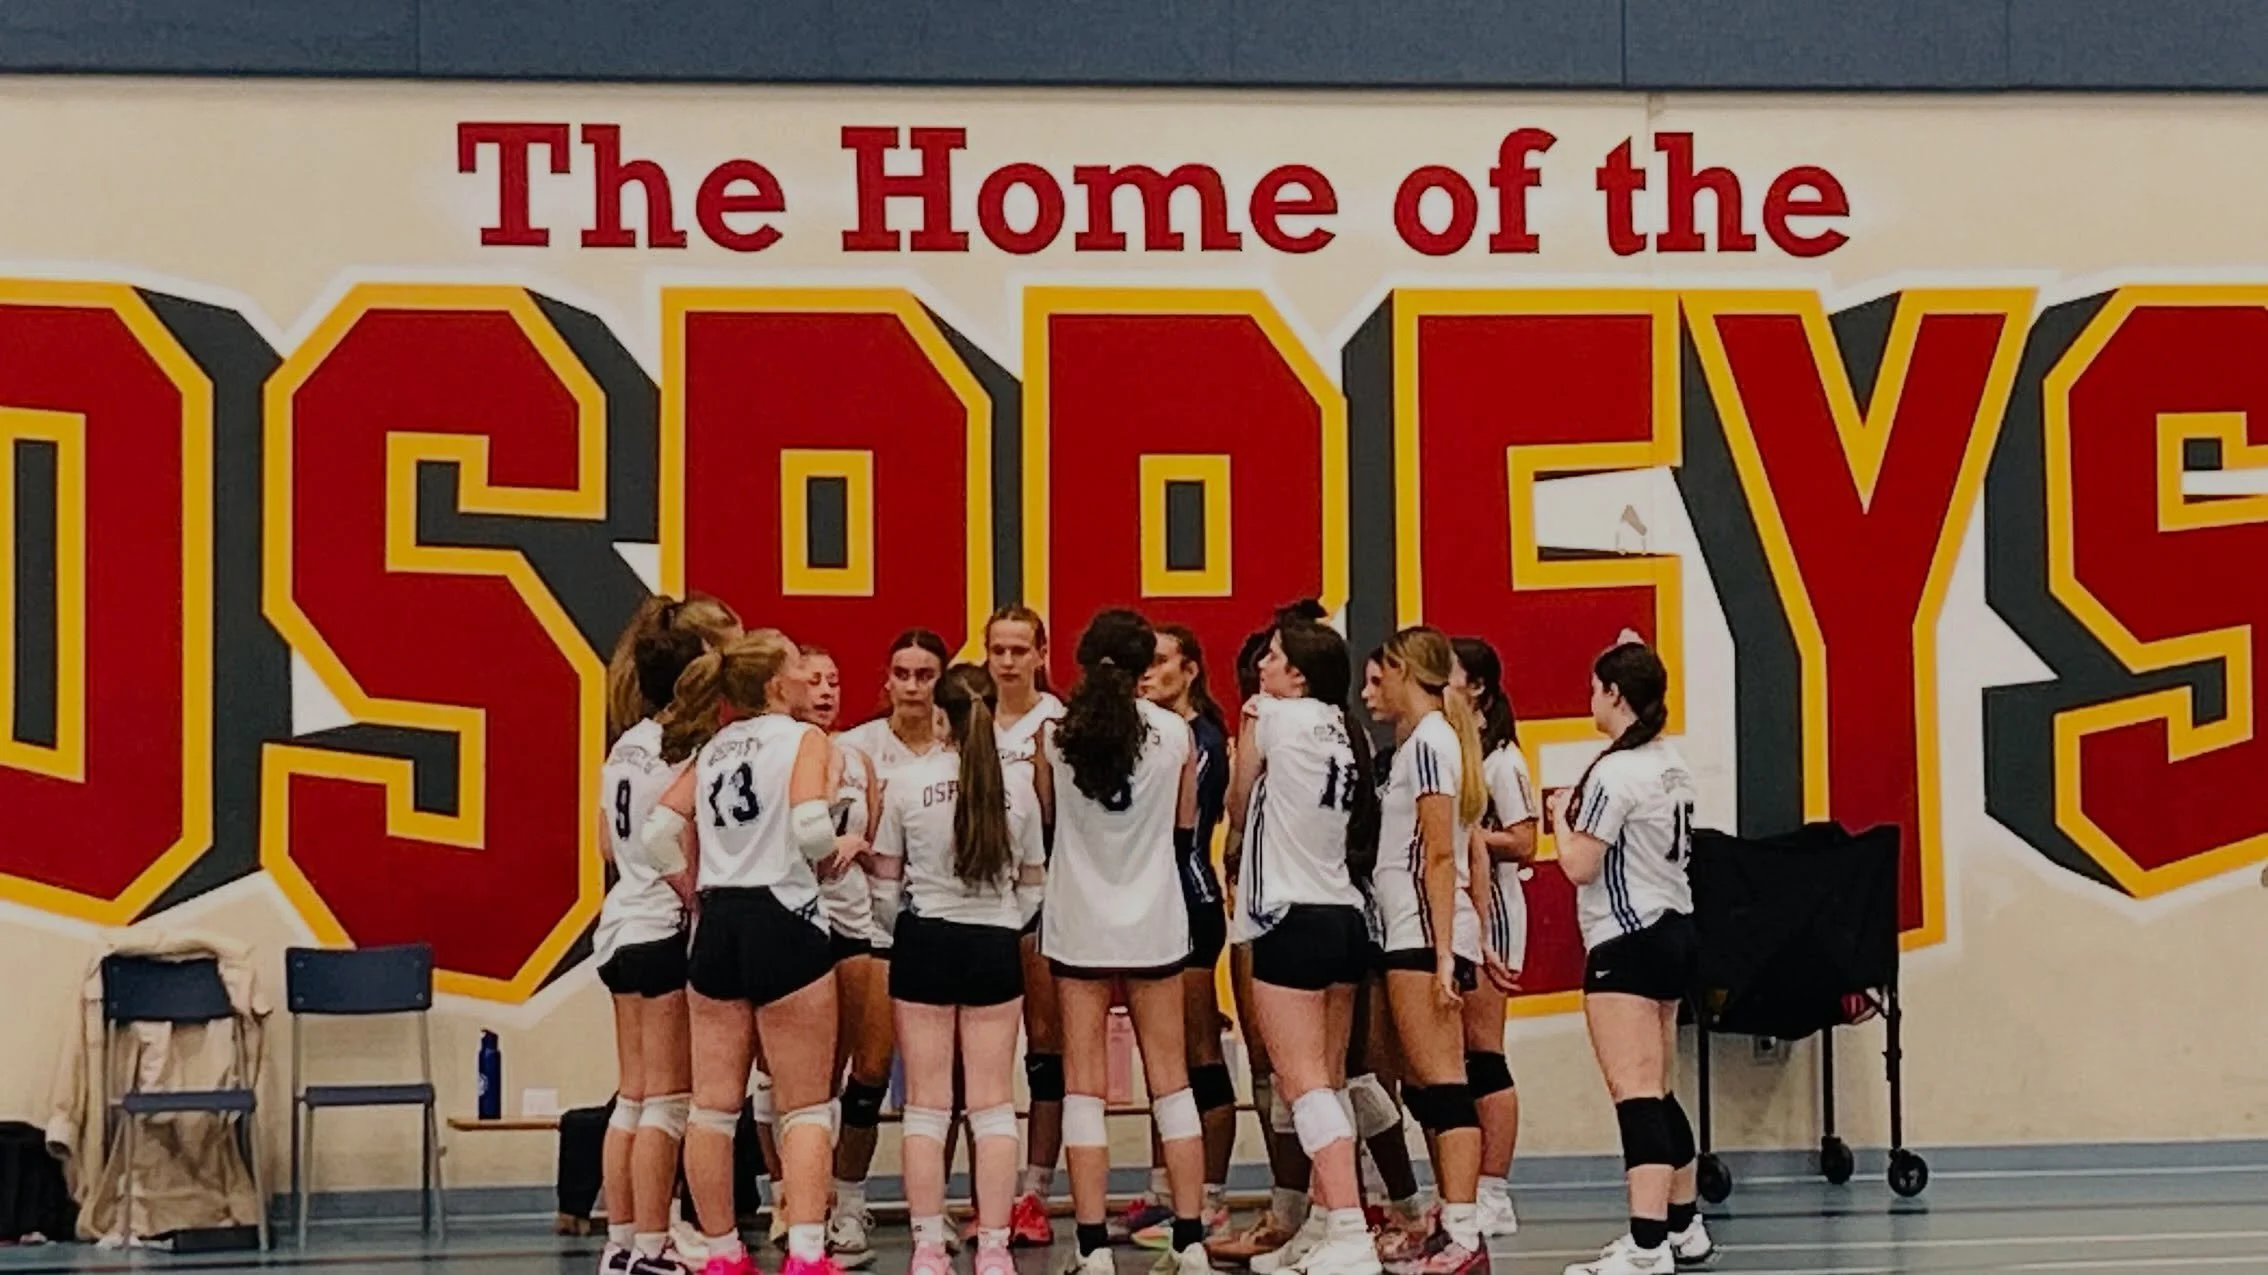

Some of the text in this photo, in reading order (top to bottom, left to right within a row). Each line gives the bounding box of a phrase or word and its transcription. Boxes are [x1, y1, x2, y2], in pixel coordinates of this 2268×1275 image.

[456, 121, 1851, 258] The Home of the
[707, 760, 761, 828] 13
